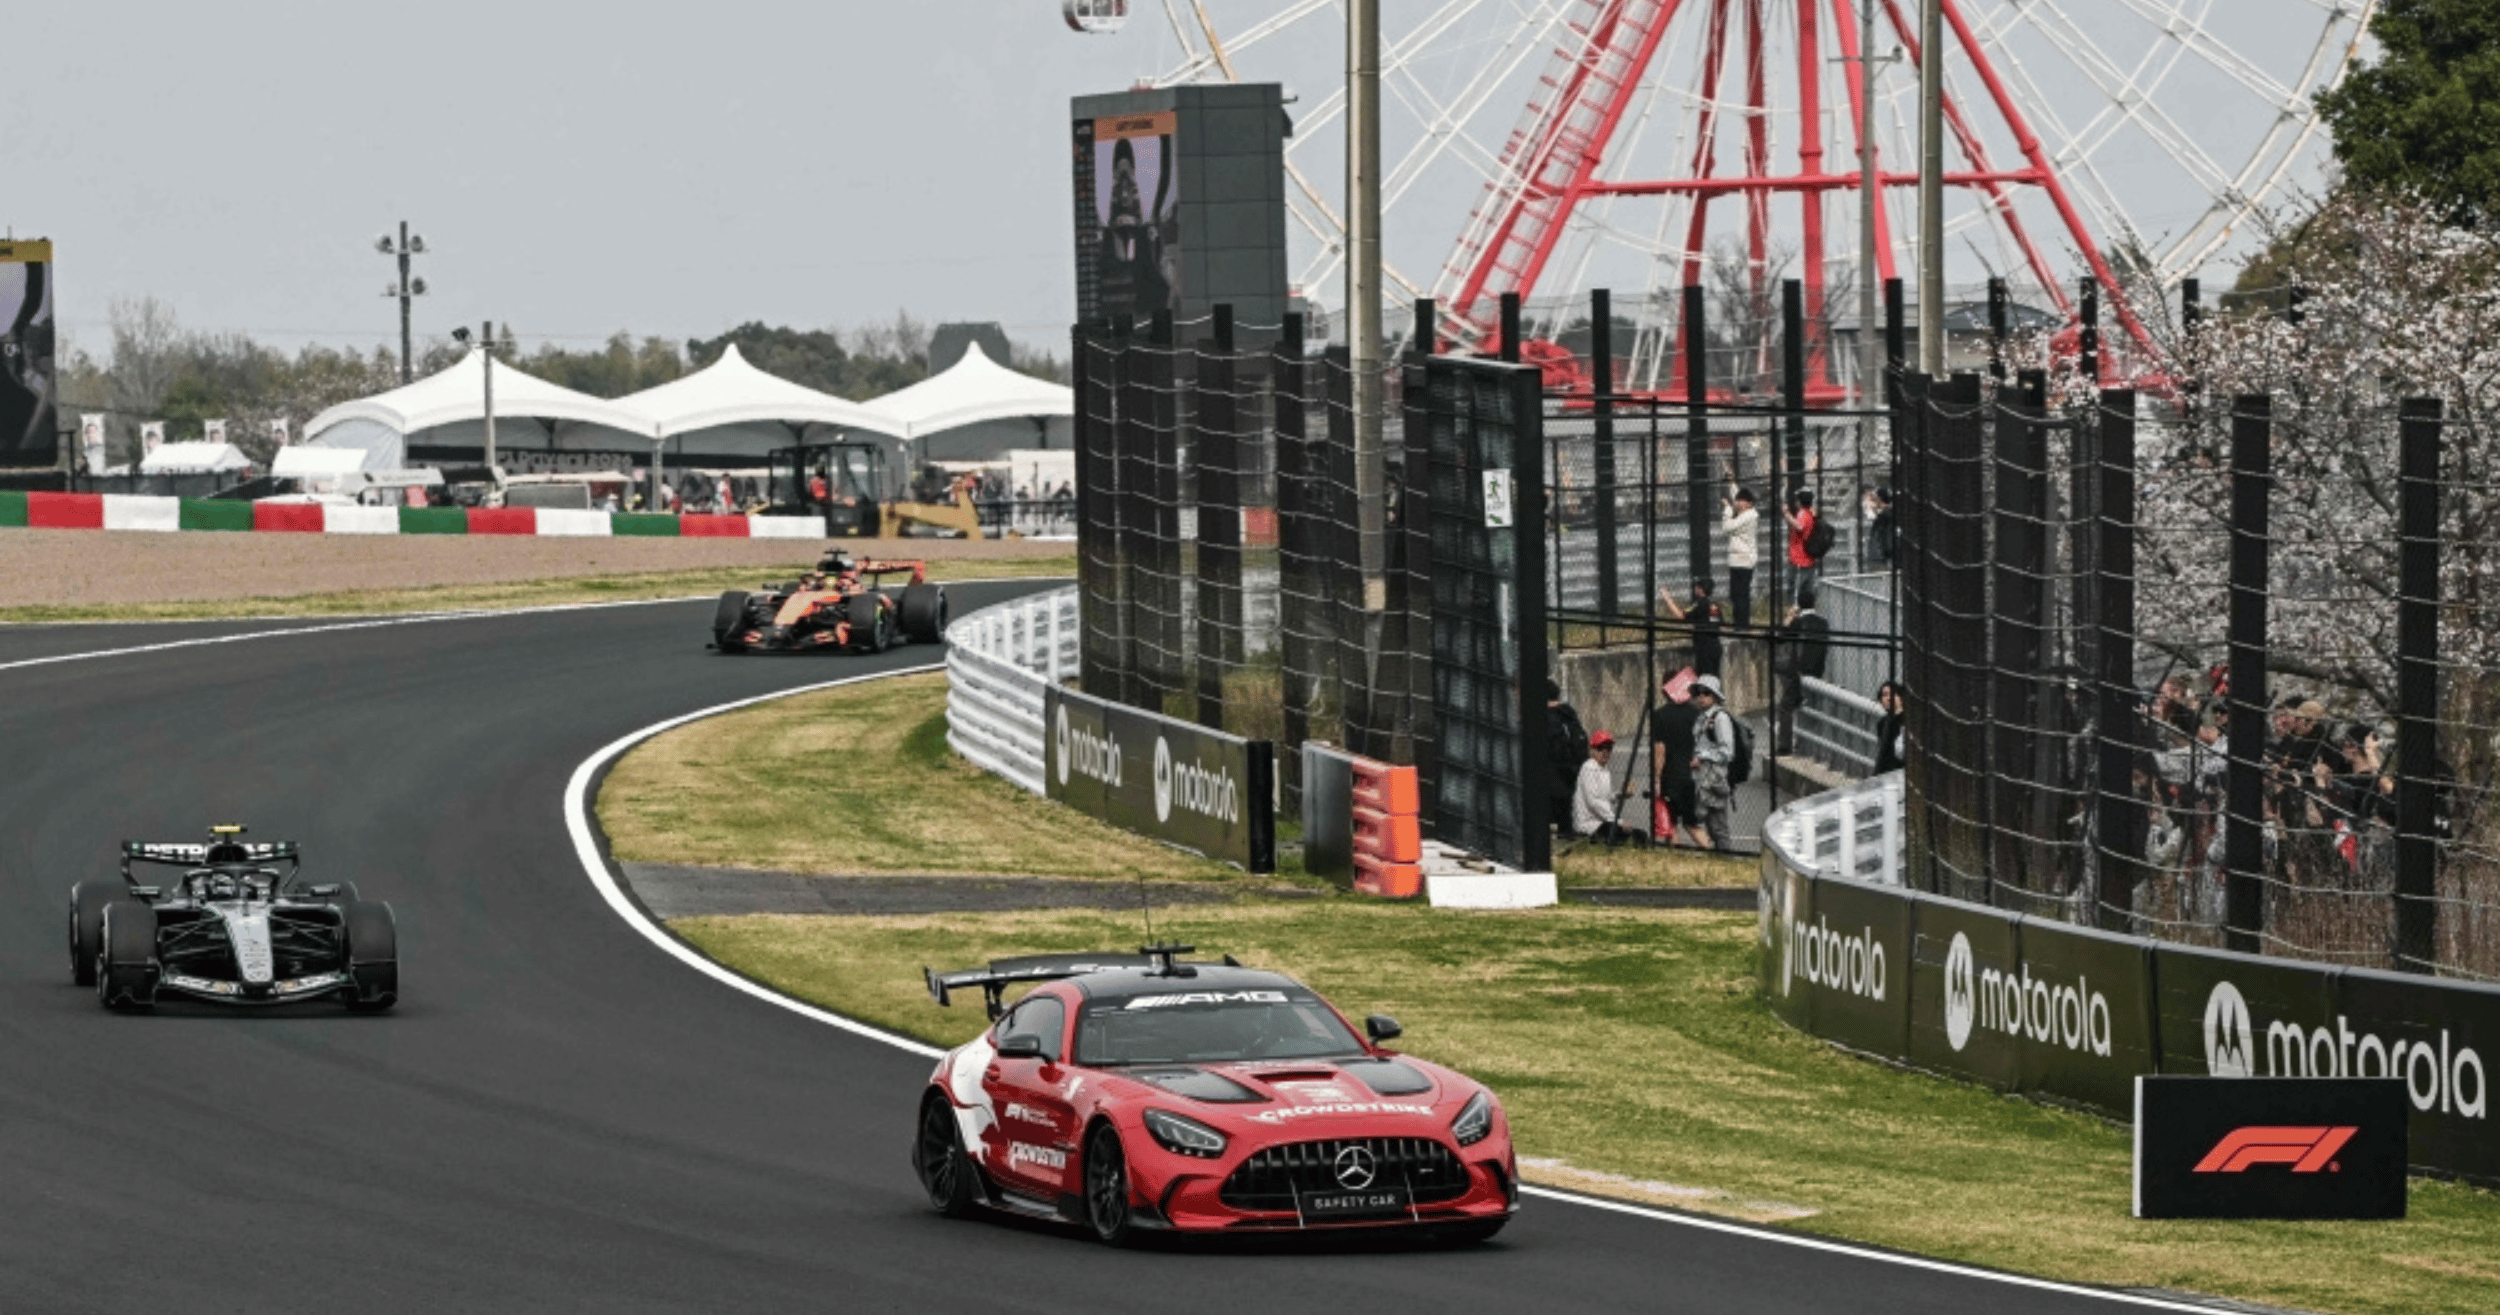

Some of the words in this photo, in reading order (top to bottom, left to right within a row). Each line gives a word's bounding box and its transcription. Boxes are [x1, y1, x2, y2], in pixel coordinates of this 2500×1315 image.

[1174, 757, 1239, 824] motorola
[1794, 914, 1886, 1001] motorola
[1981, 962, 2112, 1057] motorola
[2267, 1014, 2486, 1120] motorola
[1259, 1101, 1434, 1120] CROWDSTRIKE
[2191, 1125, 2360, 1173] F1
[1314, 1196, 1366, 1210] SAFETY
[1369, 1193, 1396, 1206] CAR
